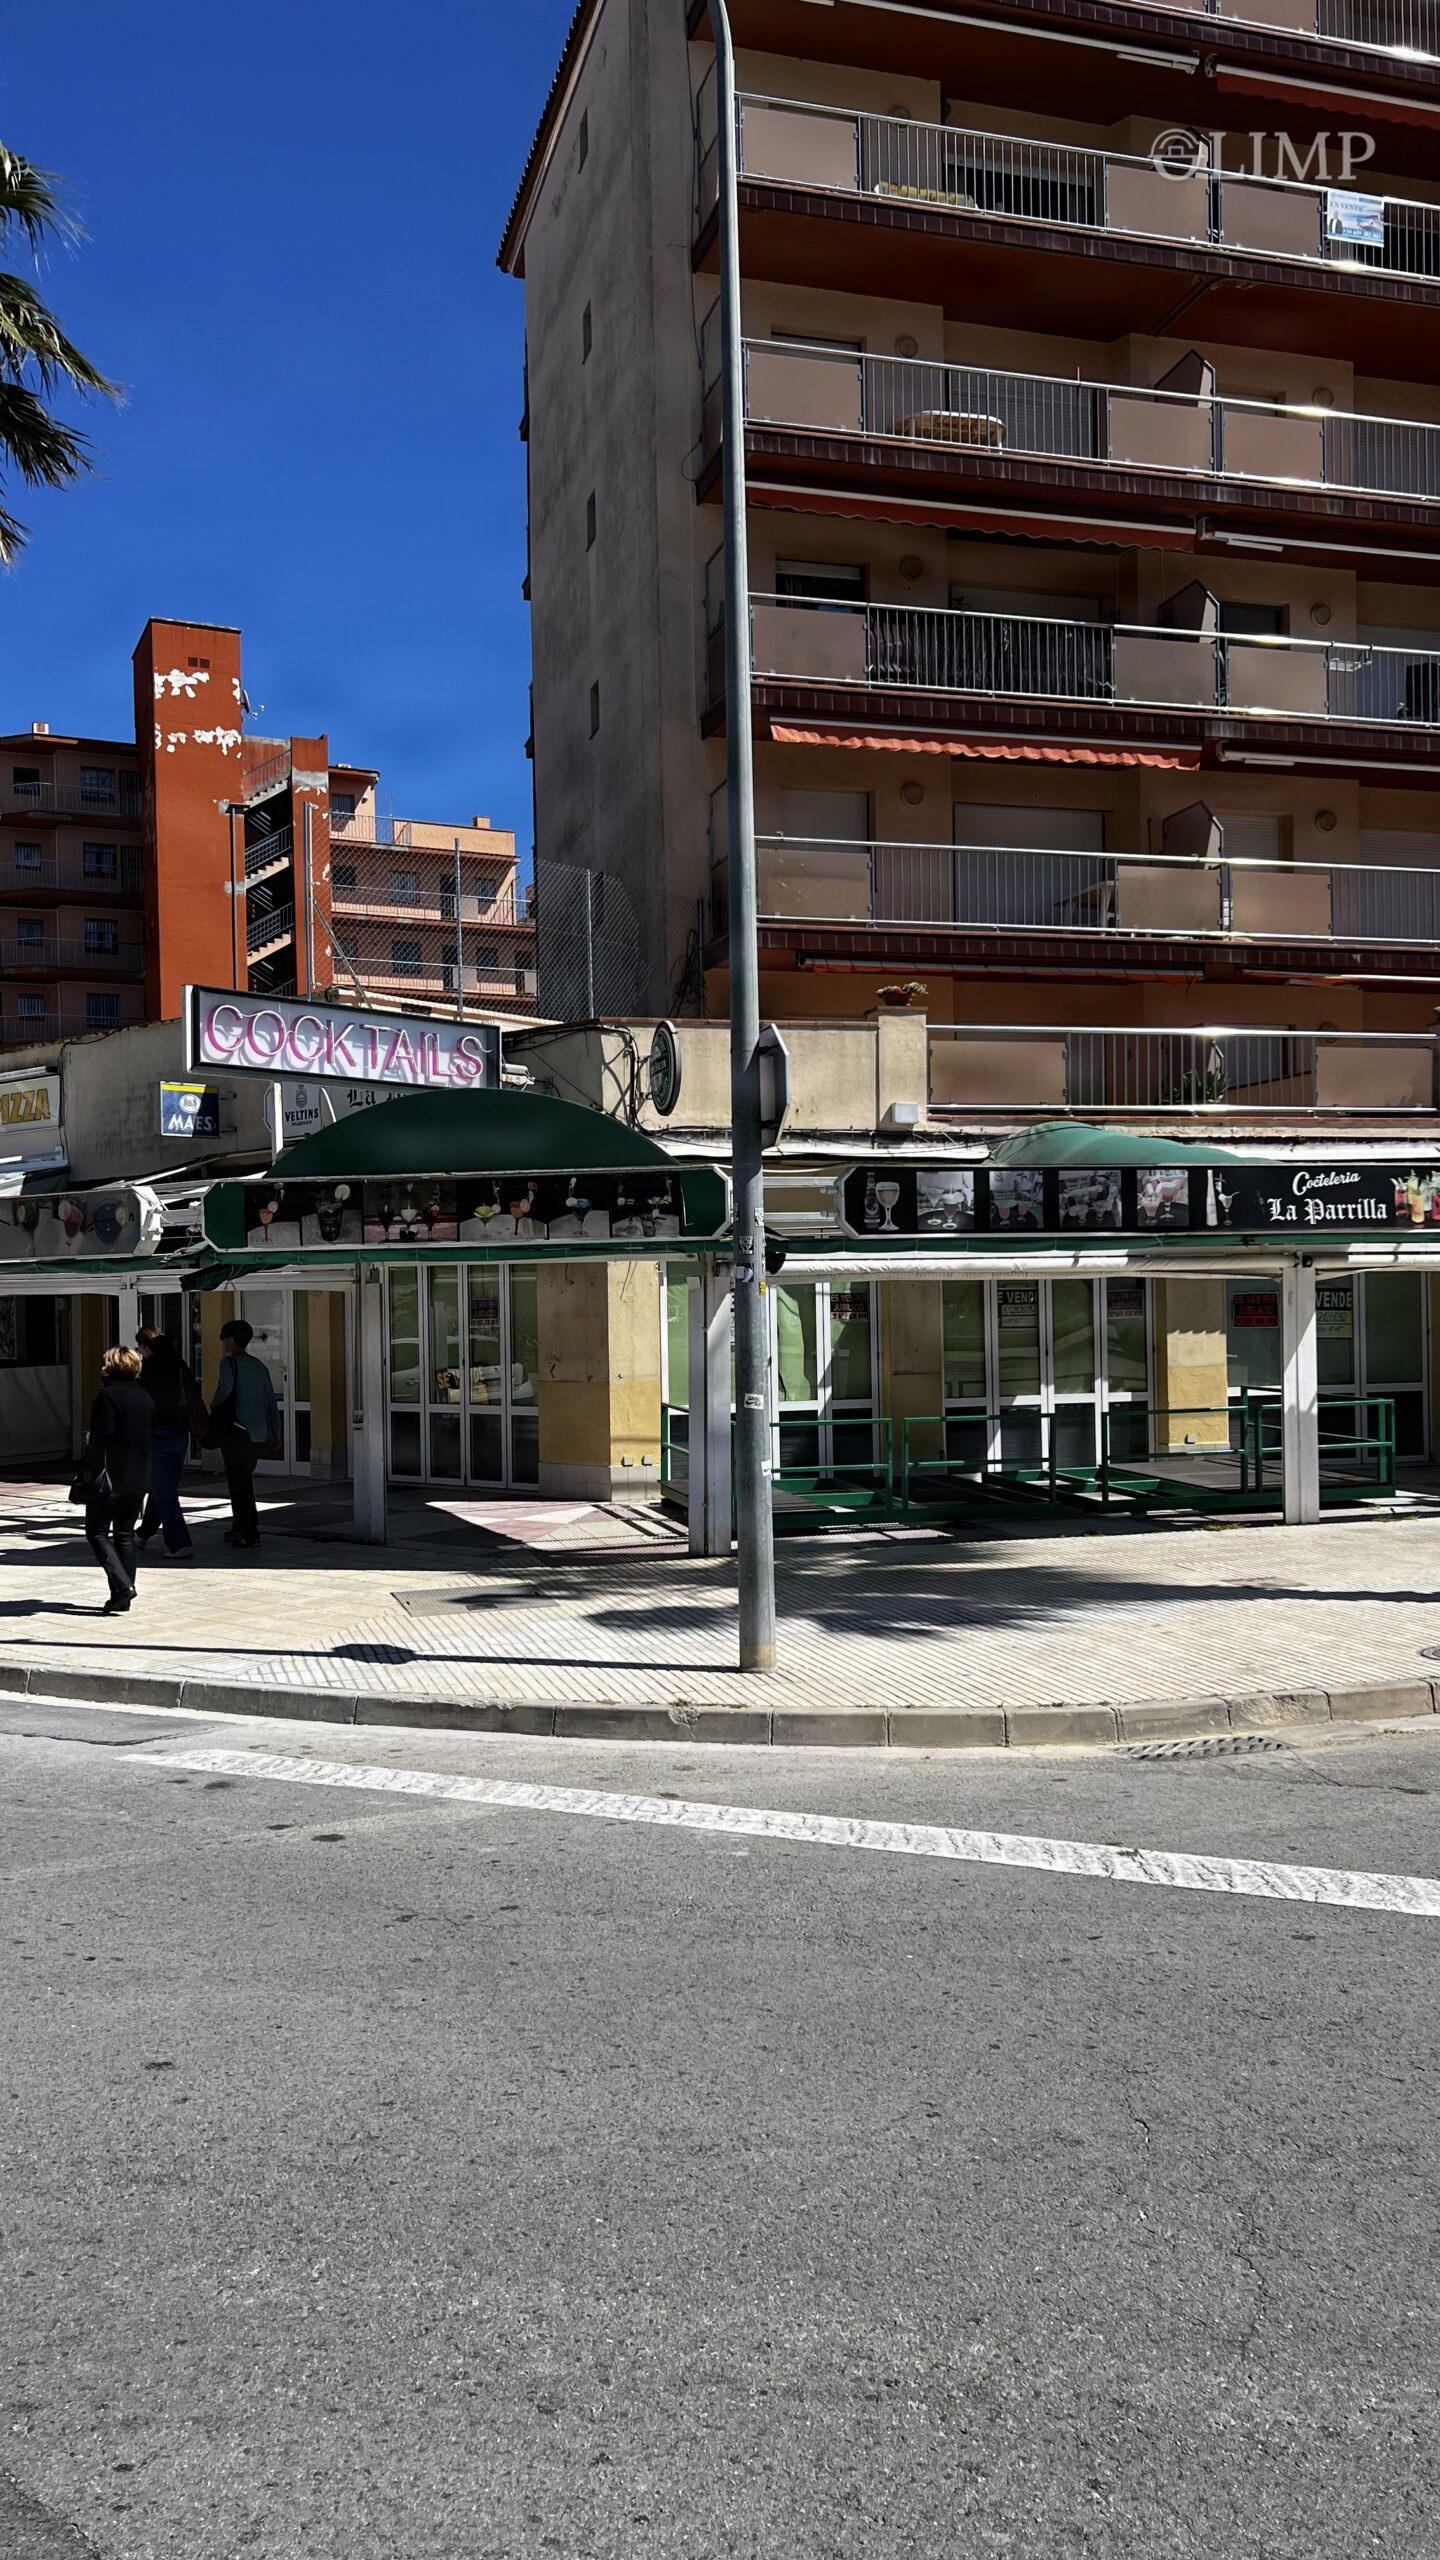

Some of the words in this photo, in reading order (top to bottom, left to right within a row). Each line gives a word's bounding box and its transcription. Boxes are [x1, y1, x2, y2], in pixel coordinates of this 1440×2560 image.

[206, 1004, 494, 1080] COCKTAILS
[0, 1088, 50, 1125] IZZA
[285, 1108, 319, 1122] VELTINS
[168, 1114, 213, 1131] MAES
[1292, 1171, 1362, 1196] Cocteleria
[1267, 1198, 1298, 1221] La
[1304, 1198, 1388, 1224] Parrilla
